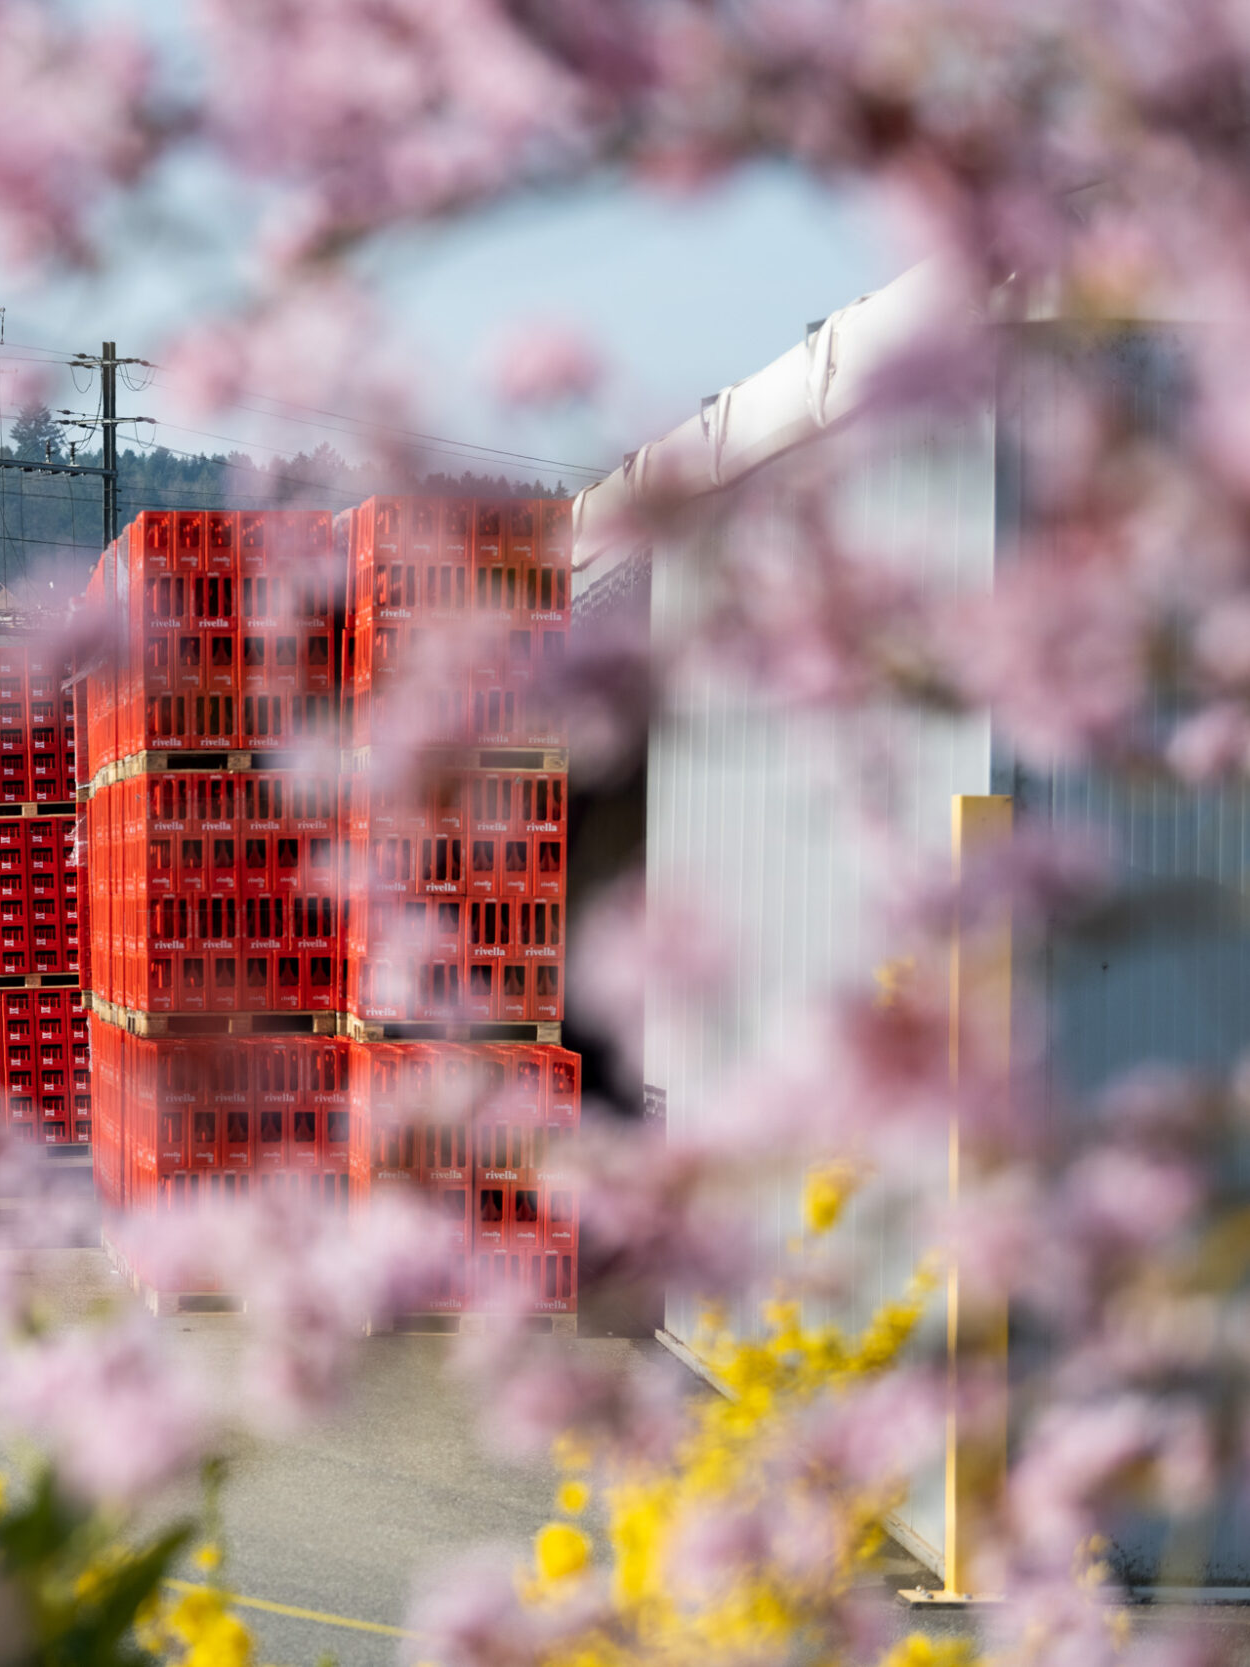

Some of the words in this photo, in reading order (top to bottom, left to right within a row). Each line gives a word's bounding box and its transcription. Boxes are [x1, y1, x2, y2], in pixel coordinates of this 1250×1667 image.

[380, 609, 411, 618] rivella
[531, 612, 562, 621] rivella
[151, 619, 180, 628] rivella
[199, 619, 228, 628] rivella
[248, 619, 277, 628] rivella
[153, 738, 182, 746] rivella
[201, 738, 230, 746] rivella
[249, 738, 278, 746] rivella
[479, 735, 508, 743] rivella
[528, 735, 559, 744] rivella
[155, 822, 184, 831] rivella
[202, 822, 231, 830] rivella
[250, 822, 279, 830] rivella
[298, 821, 326, 829] rivella
[478, 823, 507, 832] rivella
[527, 823, 557, 832] rivella
[426, 883, 456, 892] rivella
[155, 941, 184, 949] rivella
[203, 940, 232, 949] rivella
[251, 940, 280, 948] rivella
[298, 939, 327, 948] rivella
[475, 947, 505, 956] rivella
[525, 947, 556, 956] rivella
[366, 1007, 397, 1016] rivella
[166, 1093, 196, 1103] rivella
[215, 1093, 245, 1103] rivella
[265, 1093, 294, 1102] rivella
[315, 1093, 345, 1103] rivella
[378, 1170, 410, 1179] rivella
[431, 1170, 462, 1179] rivella
[486, 1171, 518, 1180] rivella
[535, 1300, 566, 1310] rivella
